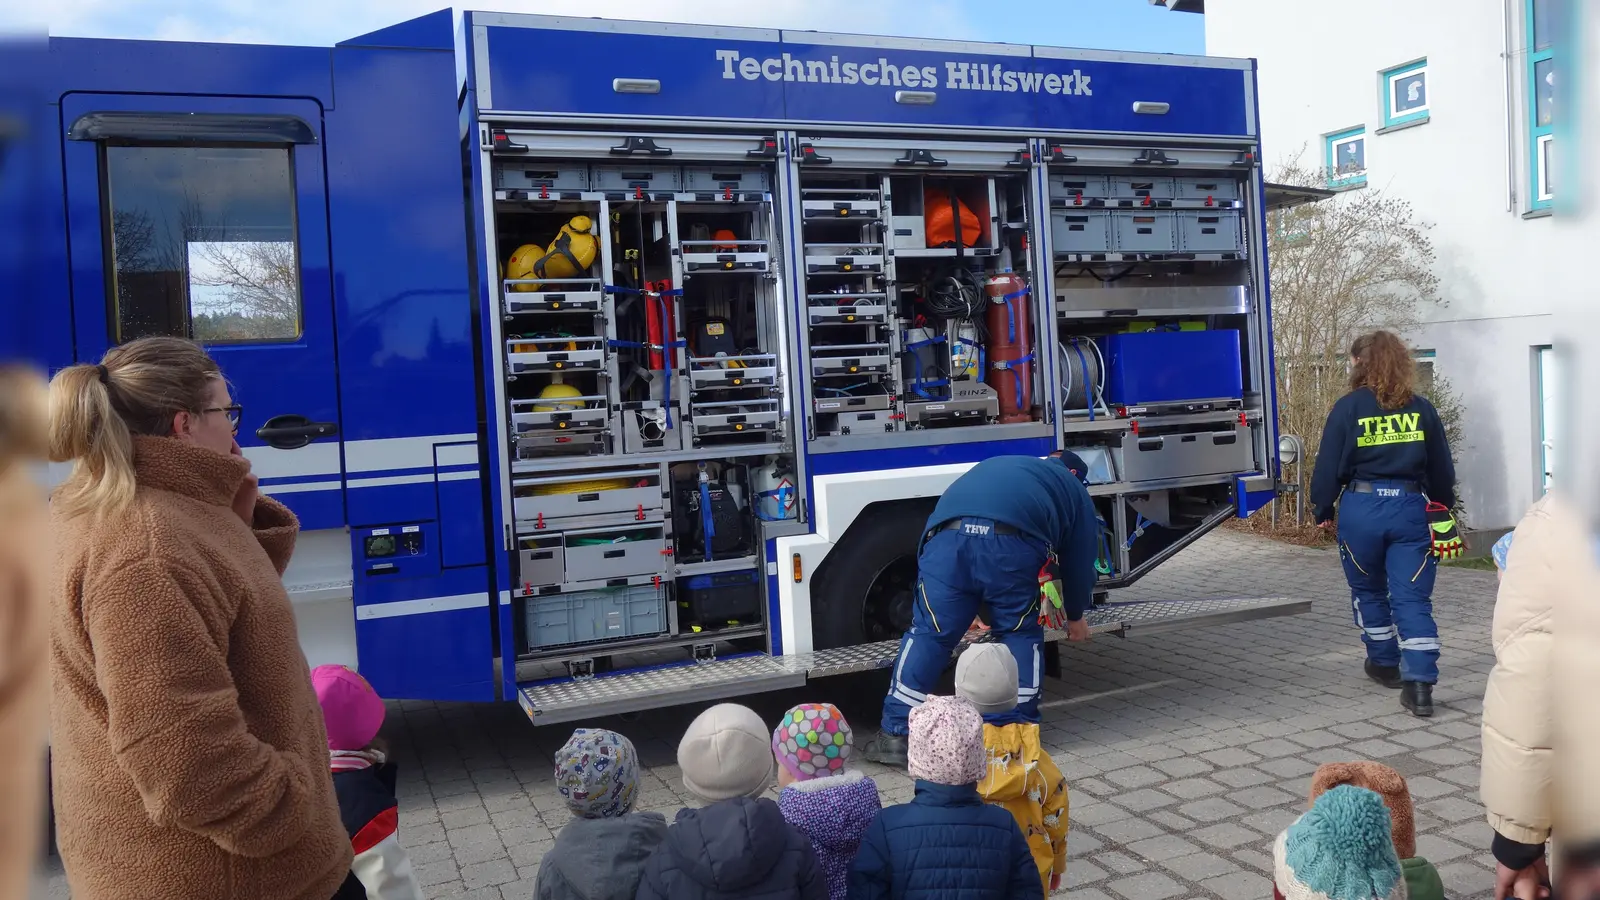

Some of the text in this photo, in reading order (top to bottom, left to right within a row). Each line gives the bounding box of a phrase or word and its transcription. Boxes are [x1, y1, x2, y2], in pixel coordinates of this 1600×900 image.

[716, 49, 1093, 96] Technisches Hilfswerk
[1358, 412, 1420, 437] THW
[1364, 432, 1419, 444] OV Amberg
[1376, 488, 1401, 497] THW
[964, 523, 990, 535] THW
